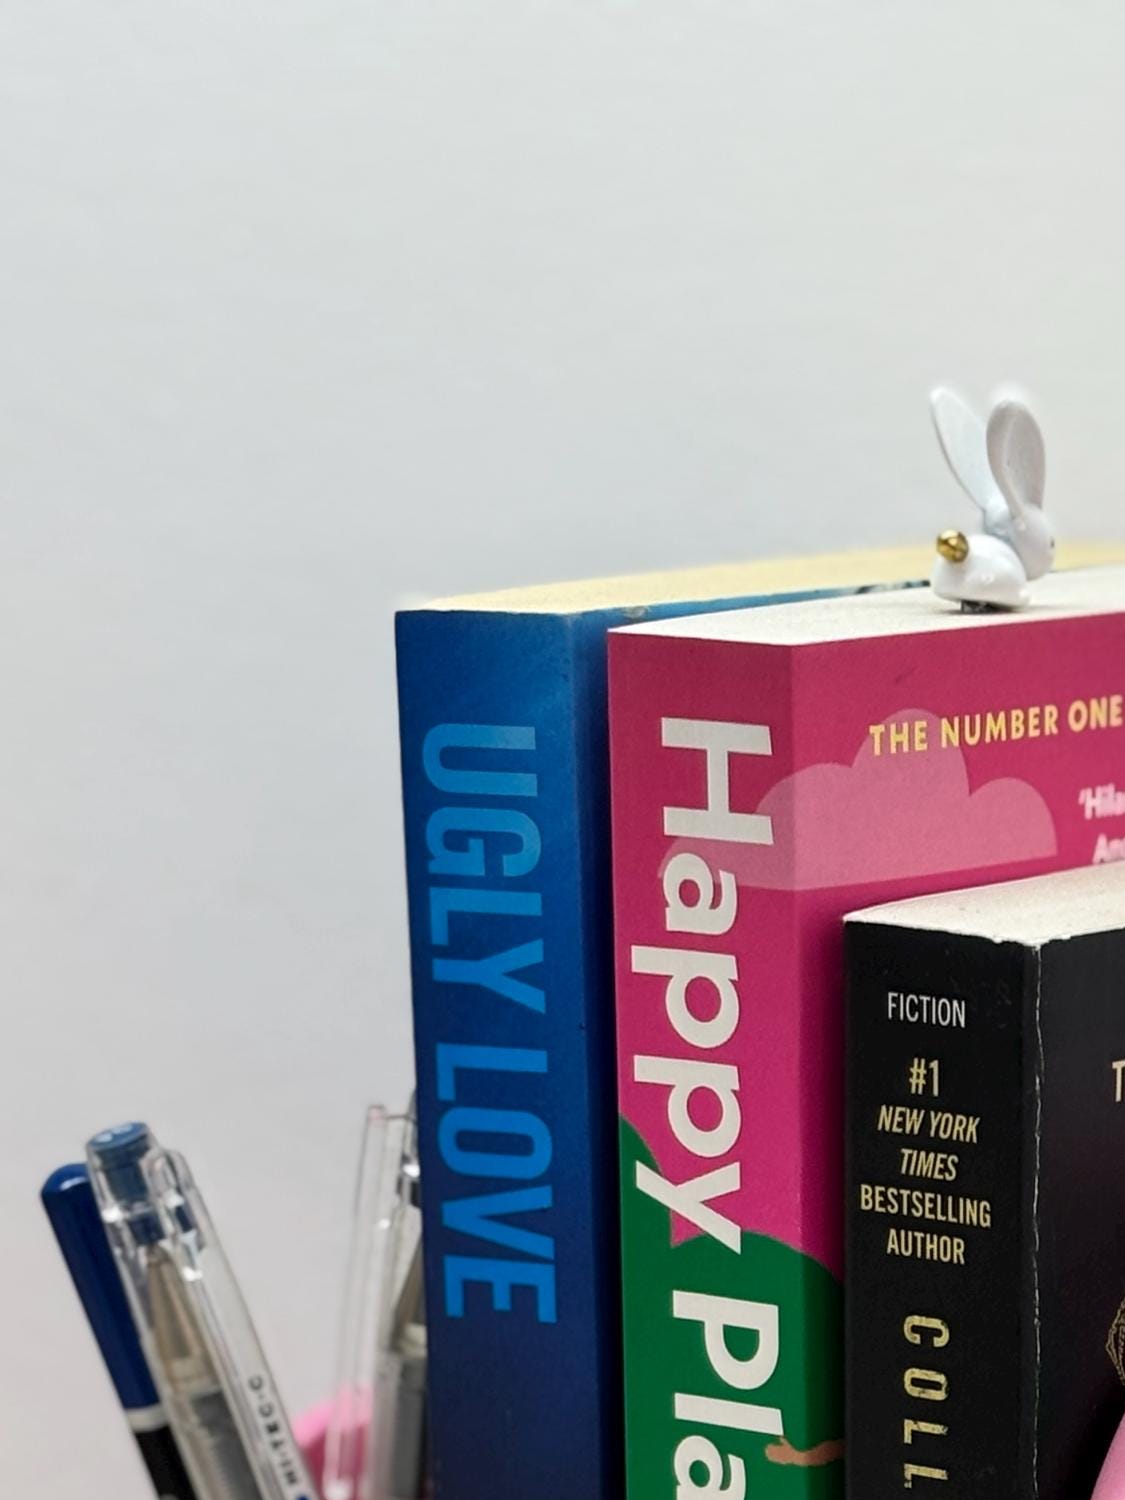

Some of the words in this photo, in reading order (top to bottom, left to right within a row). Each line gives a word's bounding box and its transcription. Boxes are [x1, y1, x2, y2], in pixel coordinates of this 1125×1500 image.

[869, 720, 929, 755] THE
[941, 705, 1059, 749] NUMBER
[1068, 697, 1123, 732] ONE
[422, 723, 546, 1015] UGLY
[630, 716, 775, 1255] Happy
[887, 991, 966, 1029] FICTION
[908, 1056, 940, 1097] #1
[877, 1104, 925, 1136] NEW
[929, 1110, 980, 1144] YORK
[435, 1042, 557, 1324] LOVE
[900, 1148, 960, 1182] TIMES
[860, 1183, 992, 1229] BESTSELLING
[886, 1228, 966, 1266] AUTHOR
